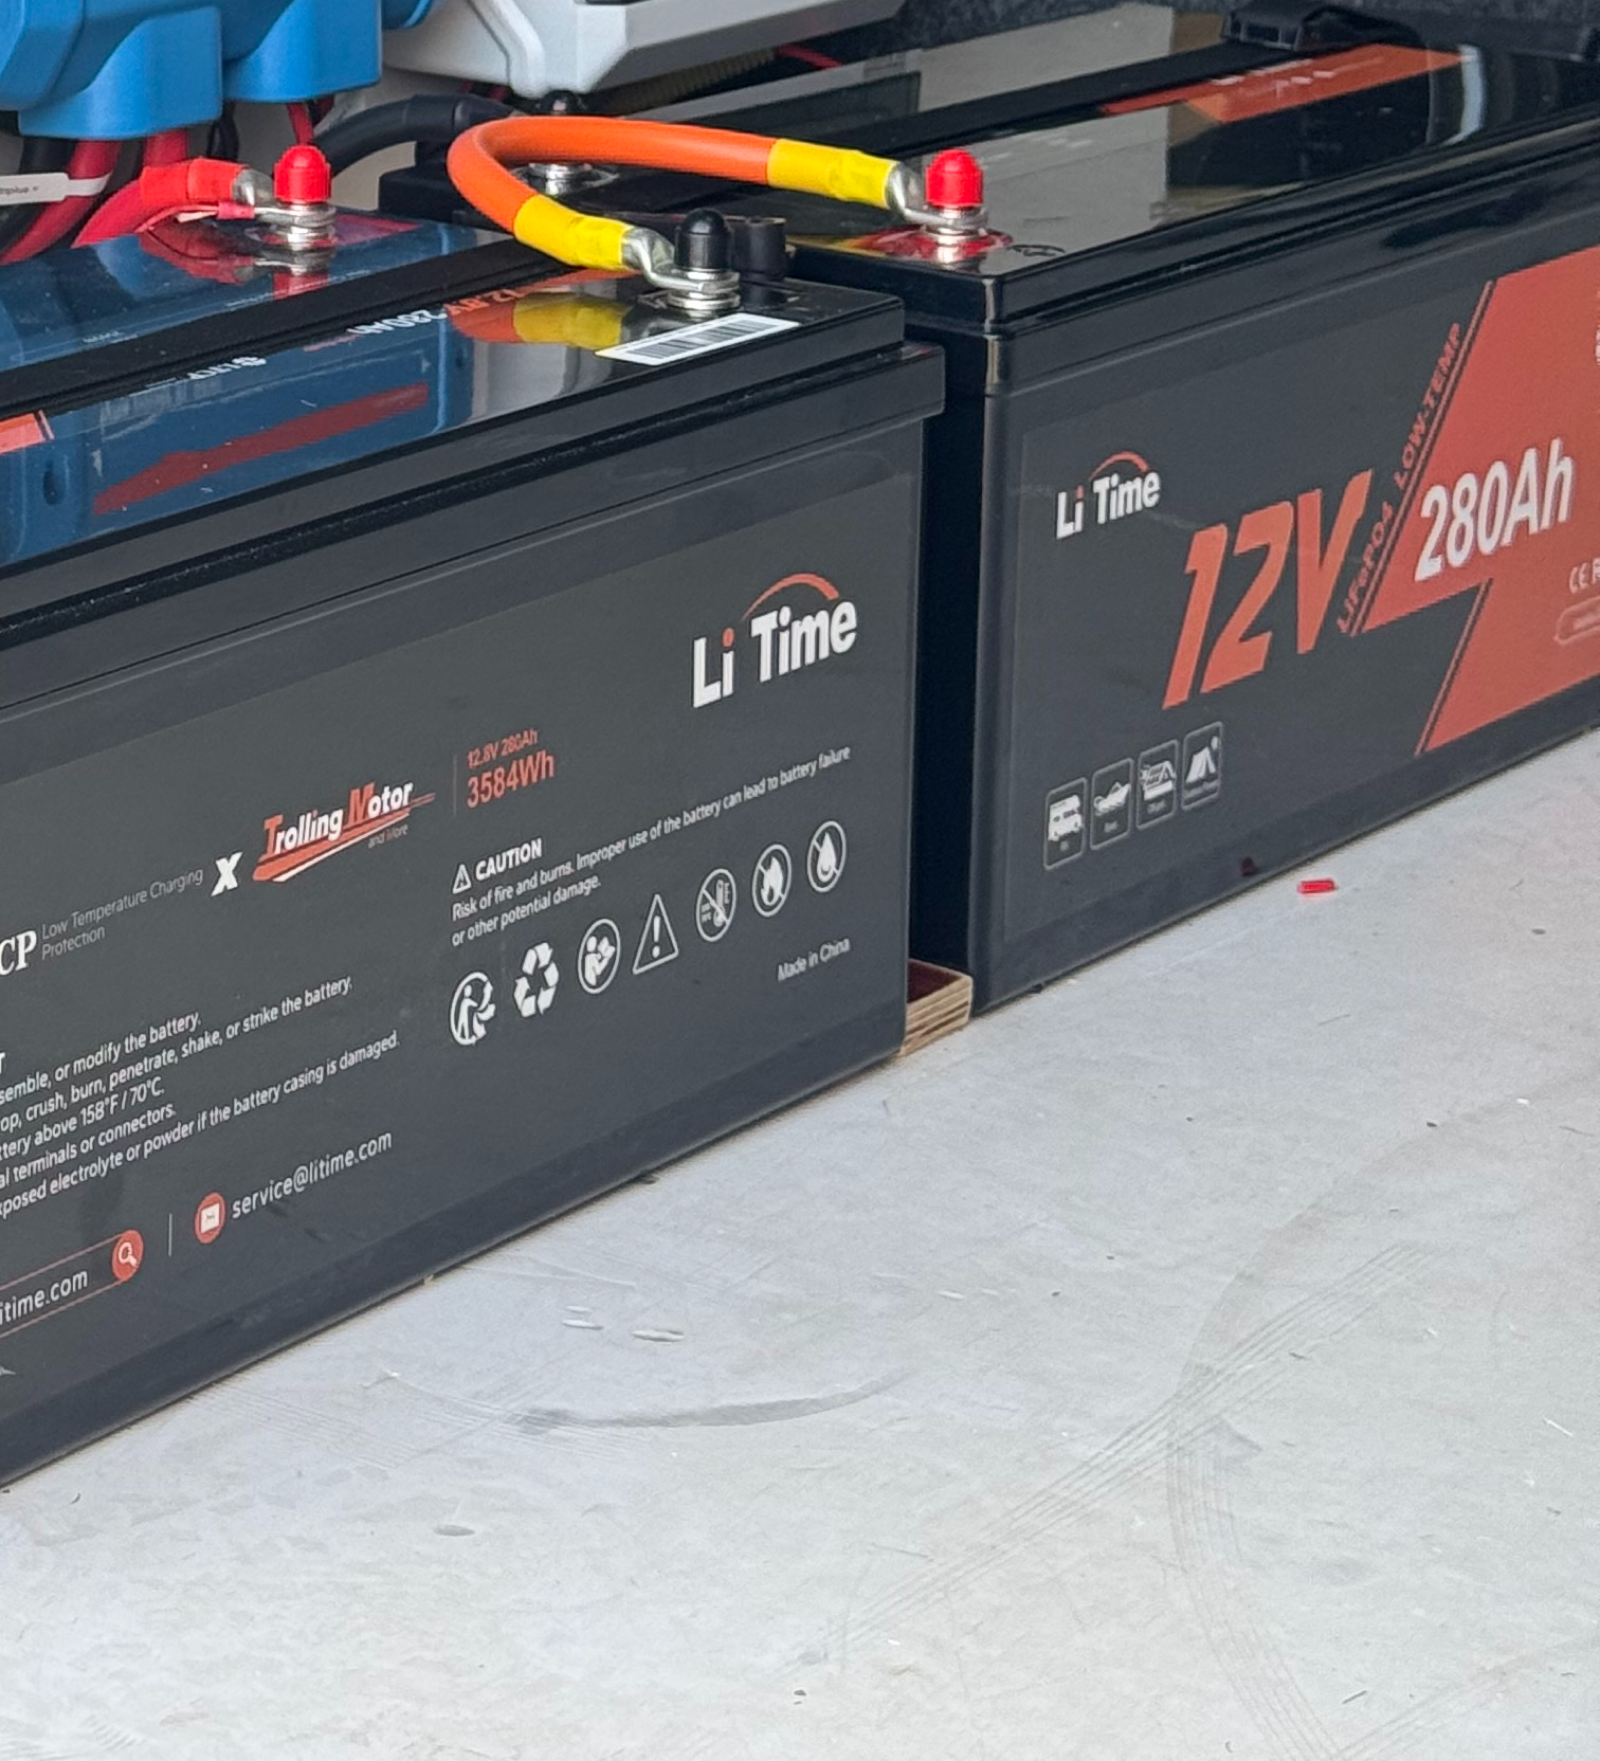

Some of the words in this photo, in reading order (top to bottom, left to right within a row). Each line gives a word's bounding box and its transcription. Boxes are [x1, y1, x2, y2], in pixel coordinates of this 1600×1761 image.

[1056, 485, 1084, 540] Li
[1093, 470, 1161, 525] Time
[1414, 438, 1575, 582] 280Ah
[1161, 469, 1374, 710] 12V
[693, 627, 735, 708] Li
[751, 600, 859, 683] Time
[467, 742, 498, 770] 12.8V
[501, 728, 539, 757] 280Ah
[467, 749, 555, 809] 3584Wh
[263, 809, 344, 856] Trolling
[345, 781, 414, 829] Motor
[452, 899, 477, 922] Risk
[479, 888, 493, 909] of
[494, 883, 514, 904] fire
[515, 872, 538, 896] and
[540, 861, 575, 885] burns.
[576, 838, 627, 871] Improper
[628, 829, 649, 850] use
[650, 819, 662, 840] of
[663, 816, 682, 835] the
[683, 798, 722, 827] battery
[723, 790, 742, 810] can
[743, 777, 766, 801] lead
[767, 775, 779, 791] to
[780, 758, 818, 786] battery
[818, 746, 851, 770] failure
[475, 837, 543, 881] CAUTION
[41, 918, 68, 940] Low
[71, 886, 148, 929] Temperature
[149, 867, 204, 900] Charging
[451, 931, 466, 947] or
[467, 916, 498, 941] other
[500, 894, 551, 931] potential
[553, 874, 602, 905] damage.
[41, 925, 106, 961] Protection
[778, 956, 807, 981] Made
[808, 950, 819, 967] in
[820, 938, 850, 963] China
[25, 1092, 68, 1122] crush,
[71, 1079, 107, 1103] burn,
[109, 1047, 179, 1091] penetrate,
[181, 1030, 223, 1058] shake,
[225, 1022, 241, 1039] or
[242, 1005, 279, 1033] strike
[281, 995, 302, 1016] the
[304, 976, 353, 1008] battery.
[54, 1064, 71, 1082] or
[73, 1041, 121, 1075] modify
[124, 1031, 147, 1054] the
[149, 1011, 202, 1044] battery.
[13, 1142, 77, 1184] terminals
[80, 1136, 96, 1154] or
[98, 1103, 177, 1147] connectors.
[49, 1150, 123, 1195] electrolyte
[126, 1144, 142, 1162] or
[144, 1120, 195, 1159] powder
[197, 1111, 208, 1131] if
[209, 1105, 231, 1127] the
[233, 1083, 282, 1116] battery
[283, 1066, 325, 1094] casing
[326, 1057, 337, 1076] is
[339, 1029, 400, 1071] damaged.
[231, 1130, 393, 1220] service@litime.com
